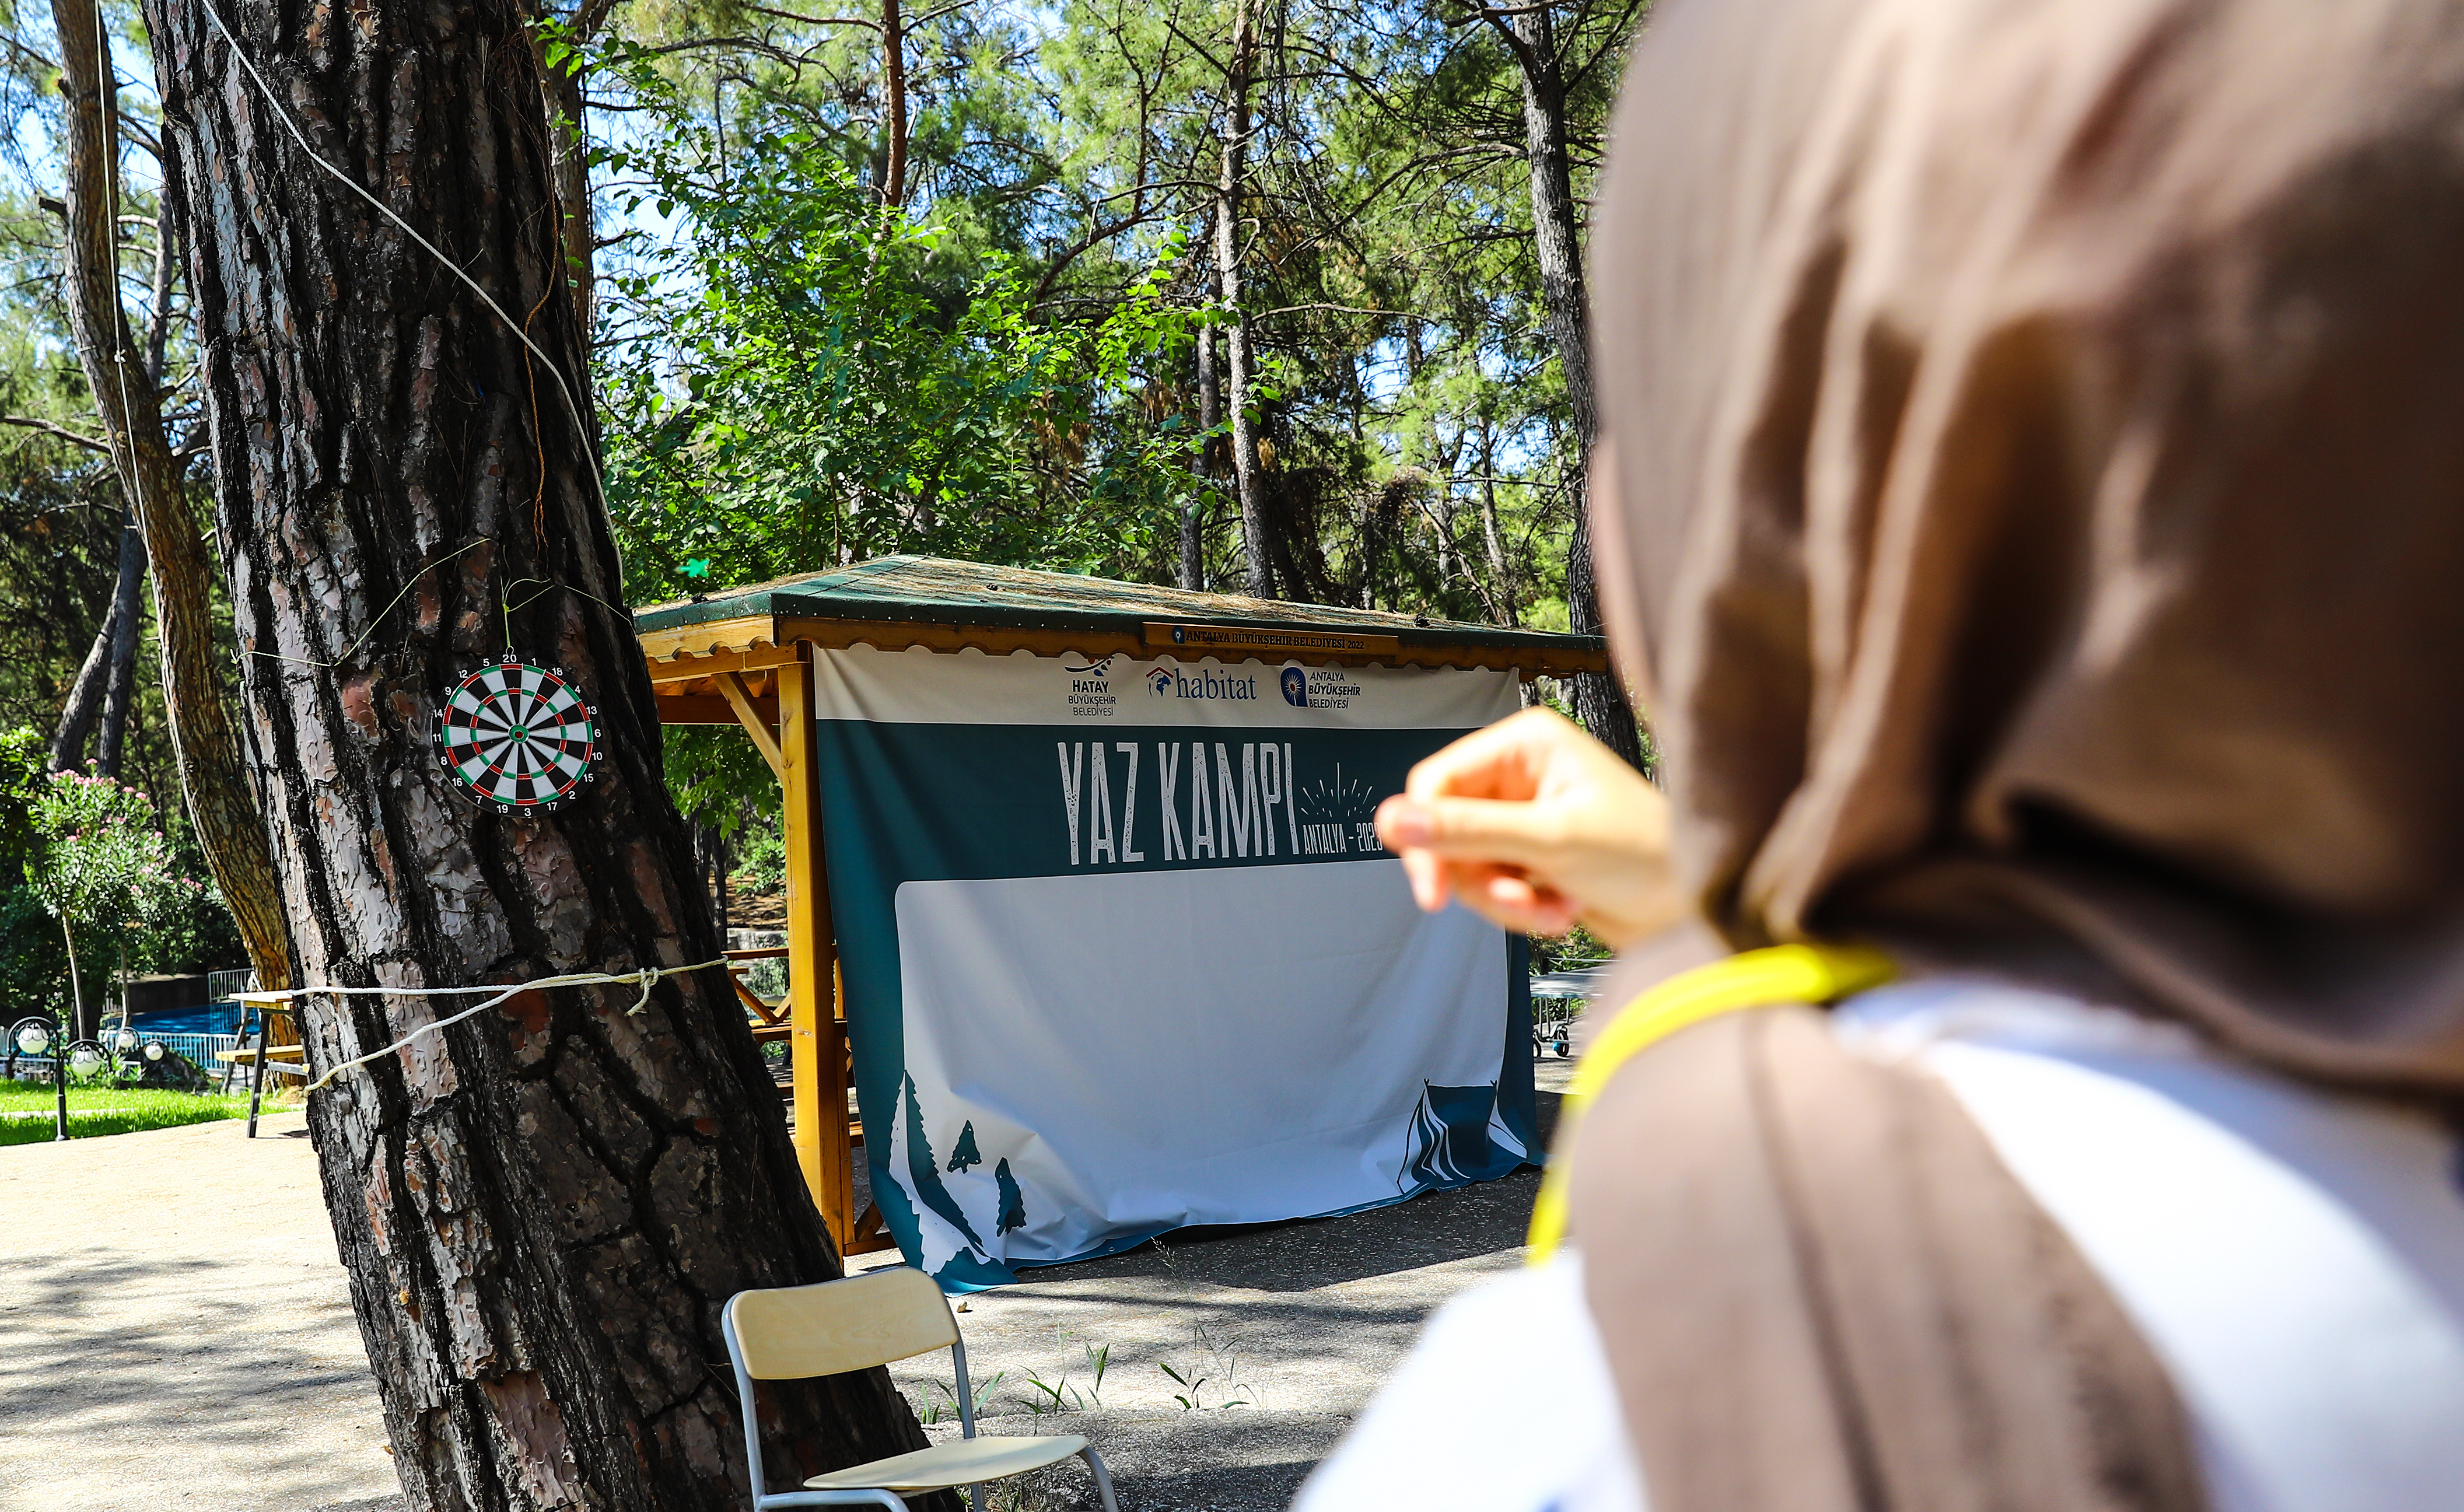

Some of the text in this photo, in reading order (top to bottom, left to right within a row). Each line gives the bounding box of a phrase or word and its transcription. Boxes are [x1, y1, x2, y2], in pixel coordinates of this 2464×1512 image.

[1186, 631, 1365, 649] ANTALYA BÜYÜKŞEHİR BELEDİYESİ 2022
[482, 658, 490, 667] 5
[502, 653, 517, 663] 20
[531, 657, 537, 666] 1
[457, 669, 468, 679] 12
[551, 667, 564, 677] 18
[1309, 671, 1345, 682] ANTALYA
[1072, 680, 1109, 693] HATAY
[1174, 667, 1257, 700] habitat
[444, 687, 452, 695] 9
[575, 685, 581, 694] 4
[1308, 682, 1362, 698] BÜYÜKŞEHİR
[1068, 694, 1116, 706] BÜYÜKŞEHİR
[1308, 696, 1349, 709] BELEDİYESİ
[433, 709, 444, 718] 14
[586, 706, 597, 715] 13
[1073, 706, 1114, 716] BELEDİYESİ
[432, 732, 443, 743] 11
[594, 729, 601, 737] 6
[440, 756, 448, 765] 8
[592, 751, 603, 761] 10
[452, 777, 463, 787] 16
[583, 773, 594, 782] 15
[475, 795, 482, 804] 7
[568, 790, 576, 800] 2
[547, 802, 558, 811] 17
[1057, 742, 1300, 865] YAZ KAMPI
[496, 804, 509, 814] 19
[524, 807, 531, 817] 3
[1303, 823, 1347, 855] ANTALYA
[1356, 822, 1383, 852] 2023
